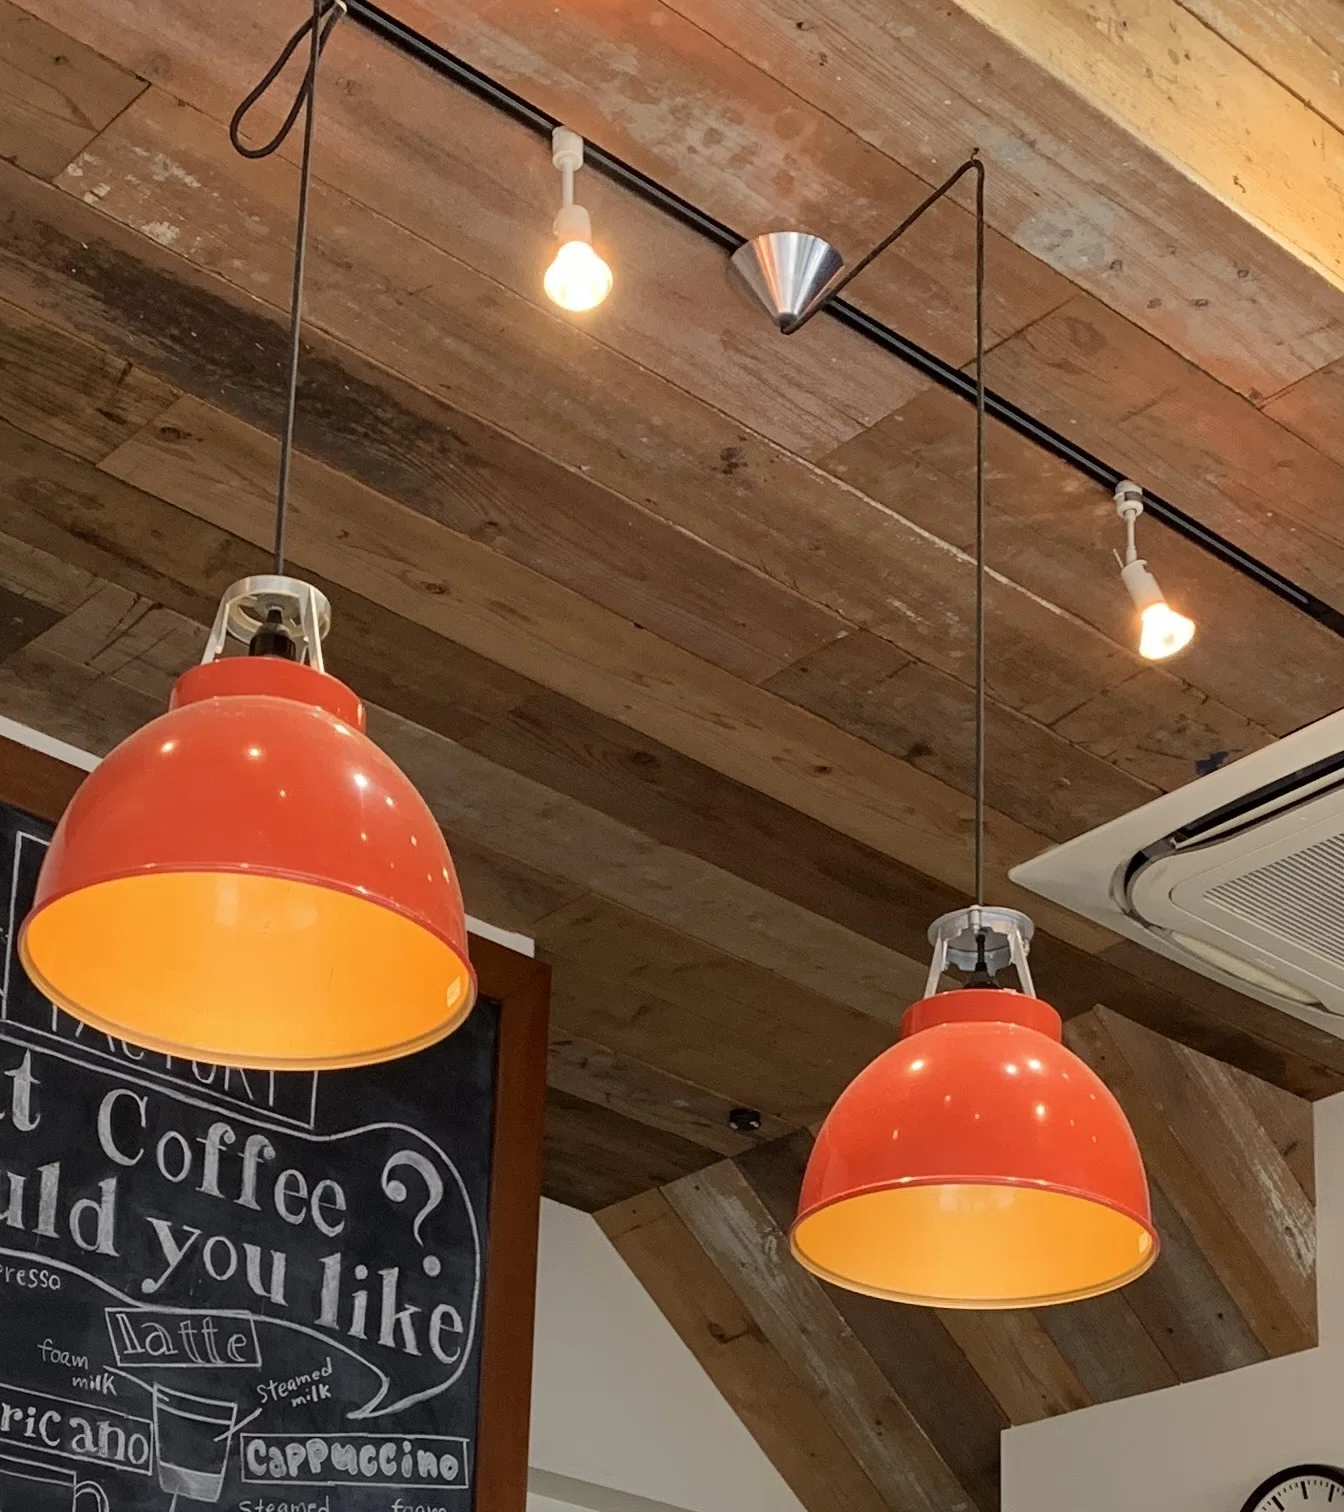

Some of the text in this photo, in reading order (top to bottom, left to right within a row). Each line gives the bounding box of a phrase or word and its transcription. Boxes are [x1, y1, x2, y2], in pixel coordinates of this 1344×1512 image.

[98, 1088, 347, 1237] Coffee
[141, 1215, 291, 1307] you
[314, 1252, 464, 1364] like
[37, 1338, 89, 1370] foam
[72, 1373, 118, 1396] milk
[291, 1384, 333, 1408] milk
